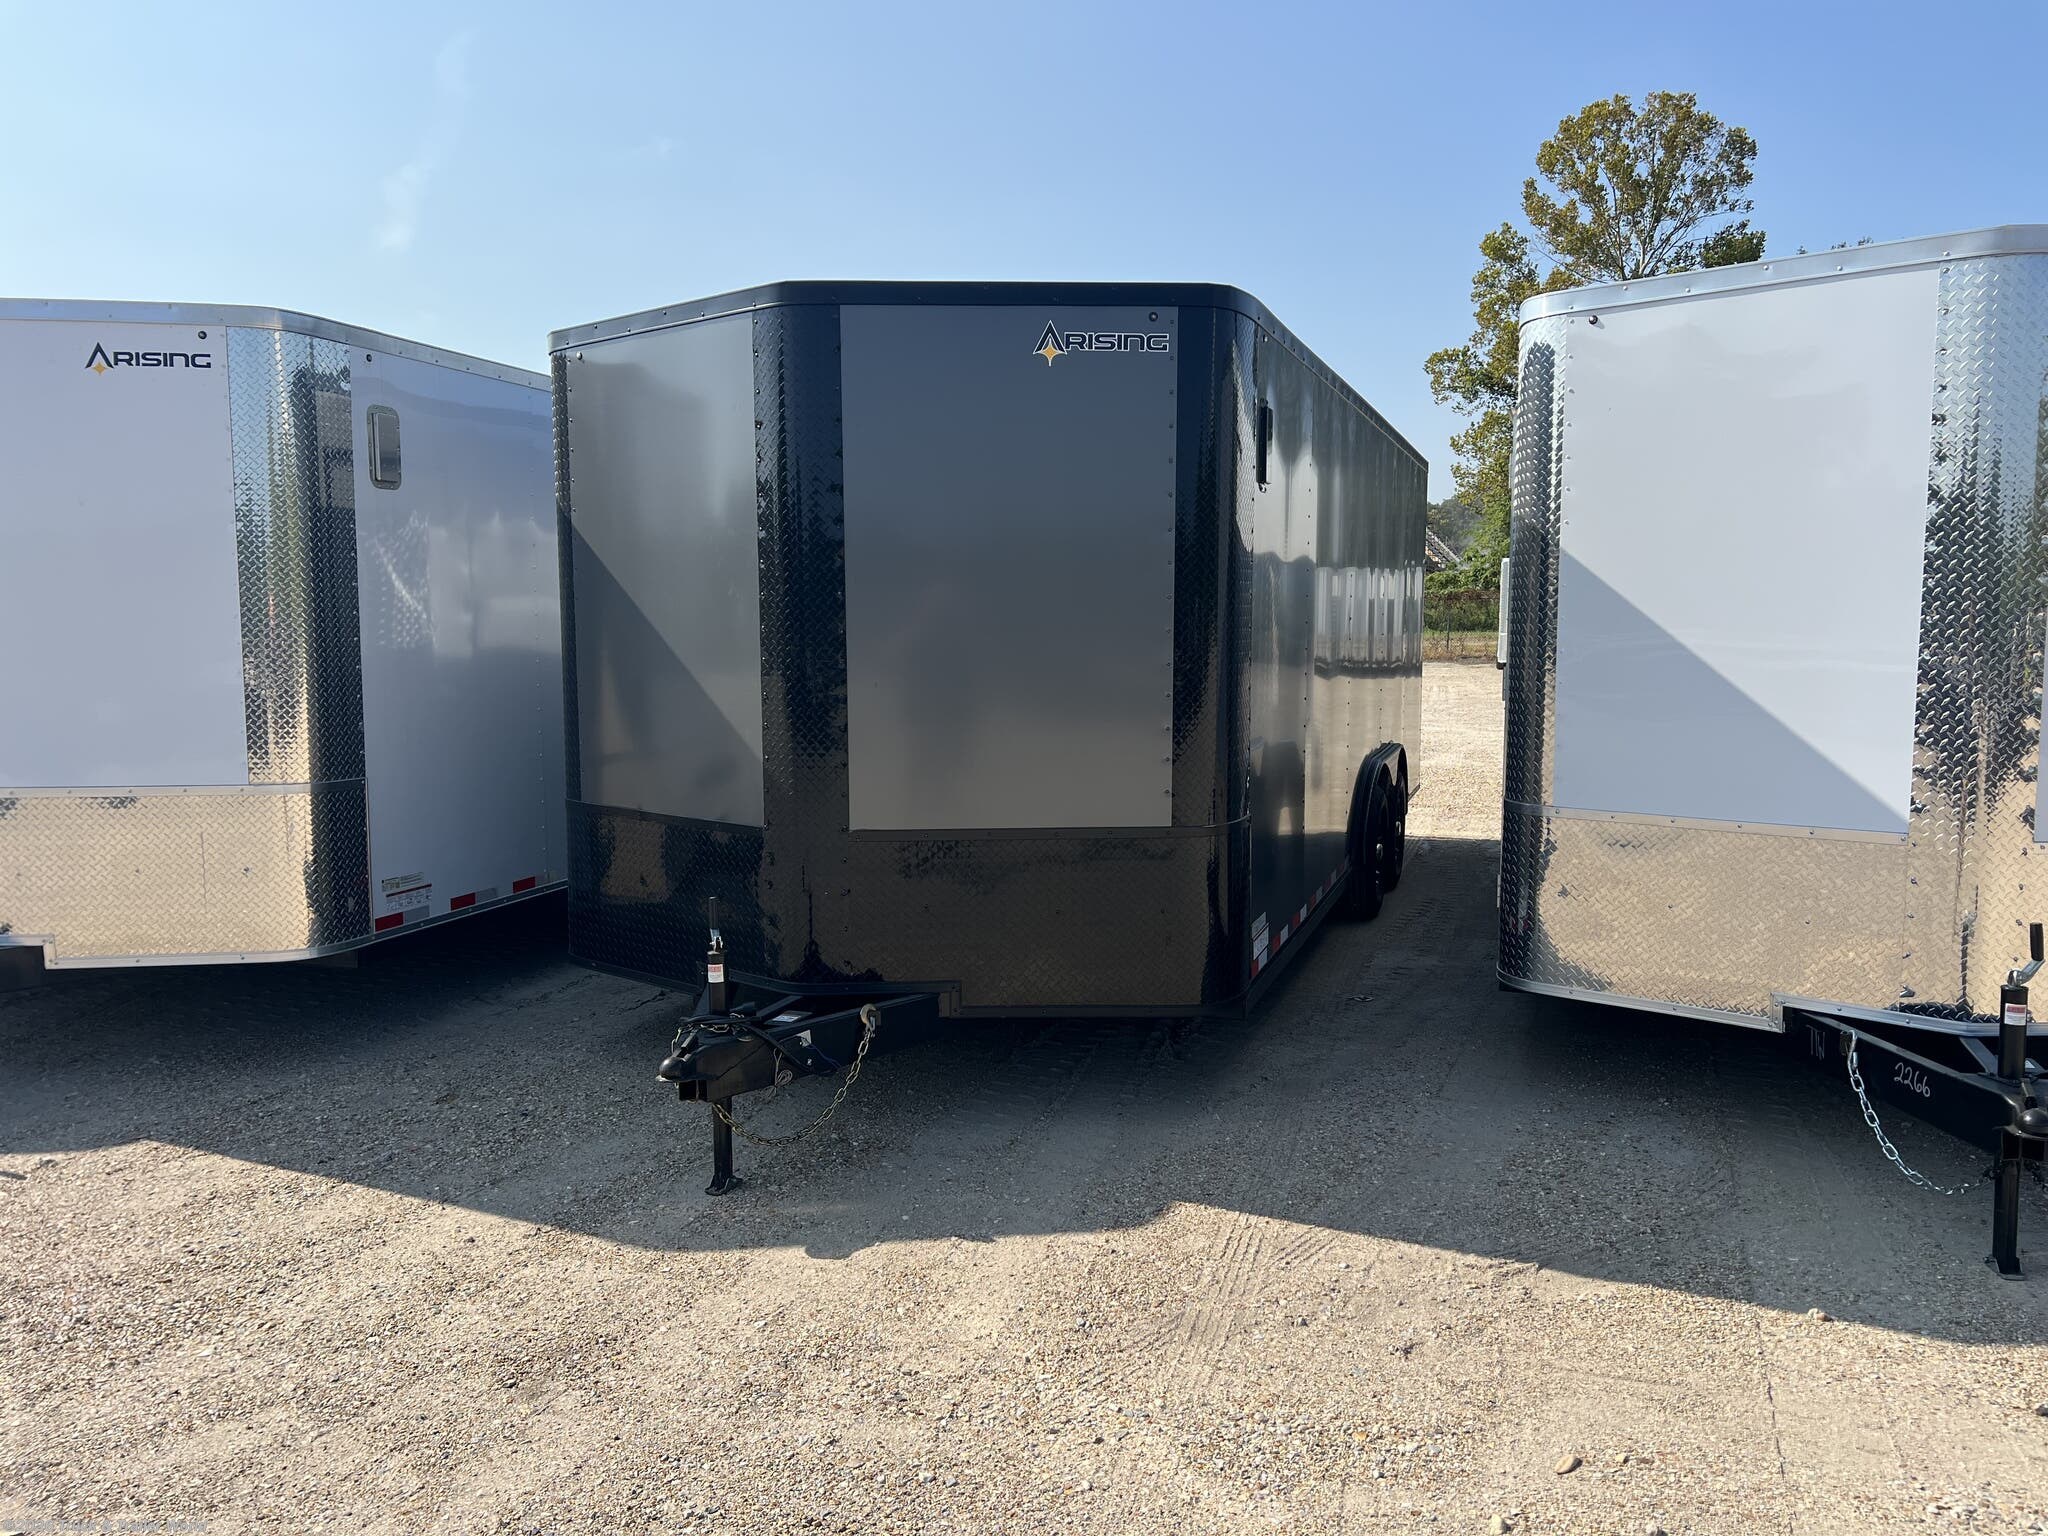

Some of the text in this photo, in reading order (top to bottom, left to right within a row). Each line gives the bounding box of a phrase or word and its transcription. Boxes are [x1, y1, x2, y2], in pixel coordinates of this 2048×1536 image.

[1033, 320, 1169, 354] ARISING
[84, 341, 212, 370] ARISING
[1893, 1062, 1931, 1097] 2266
